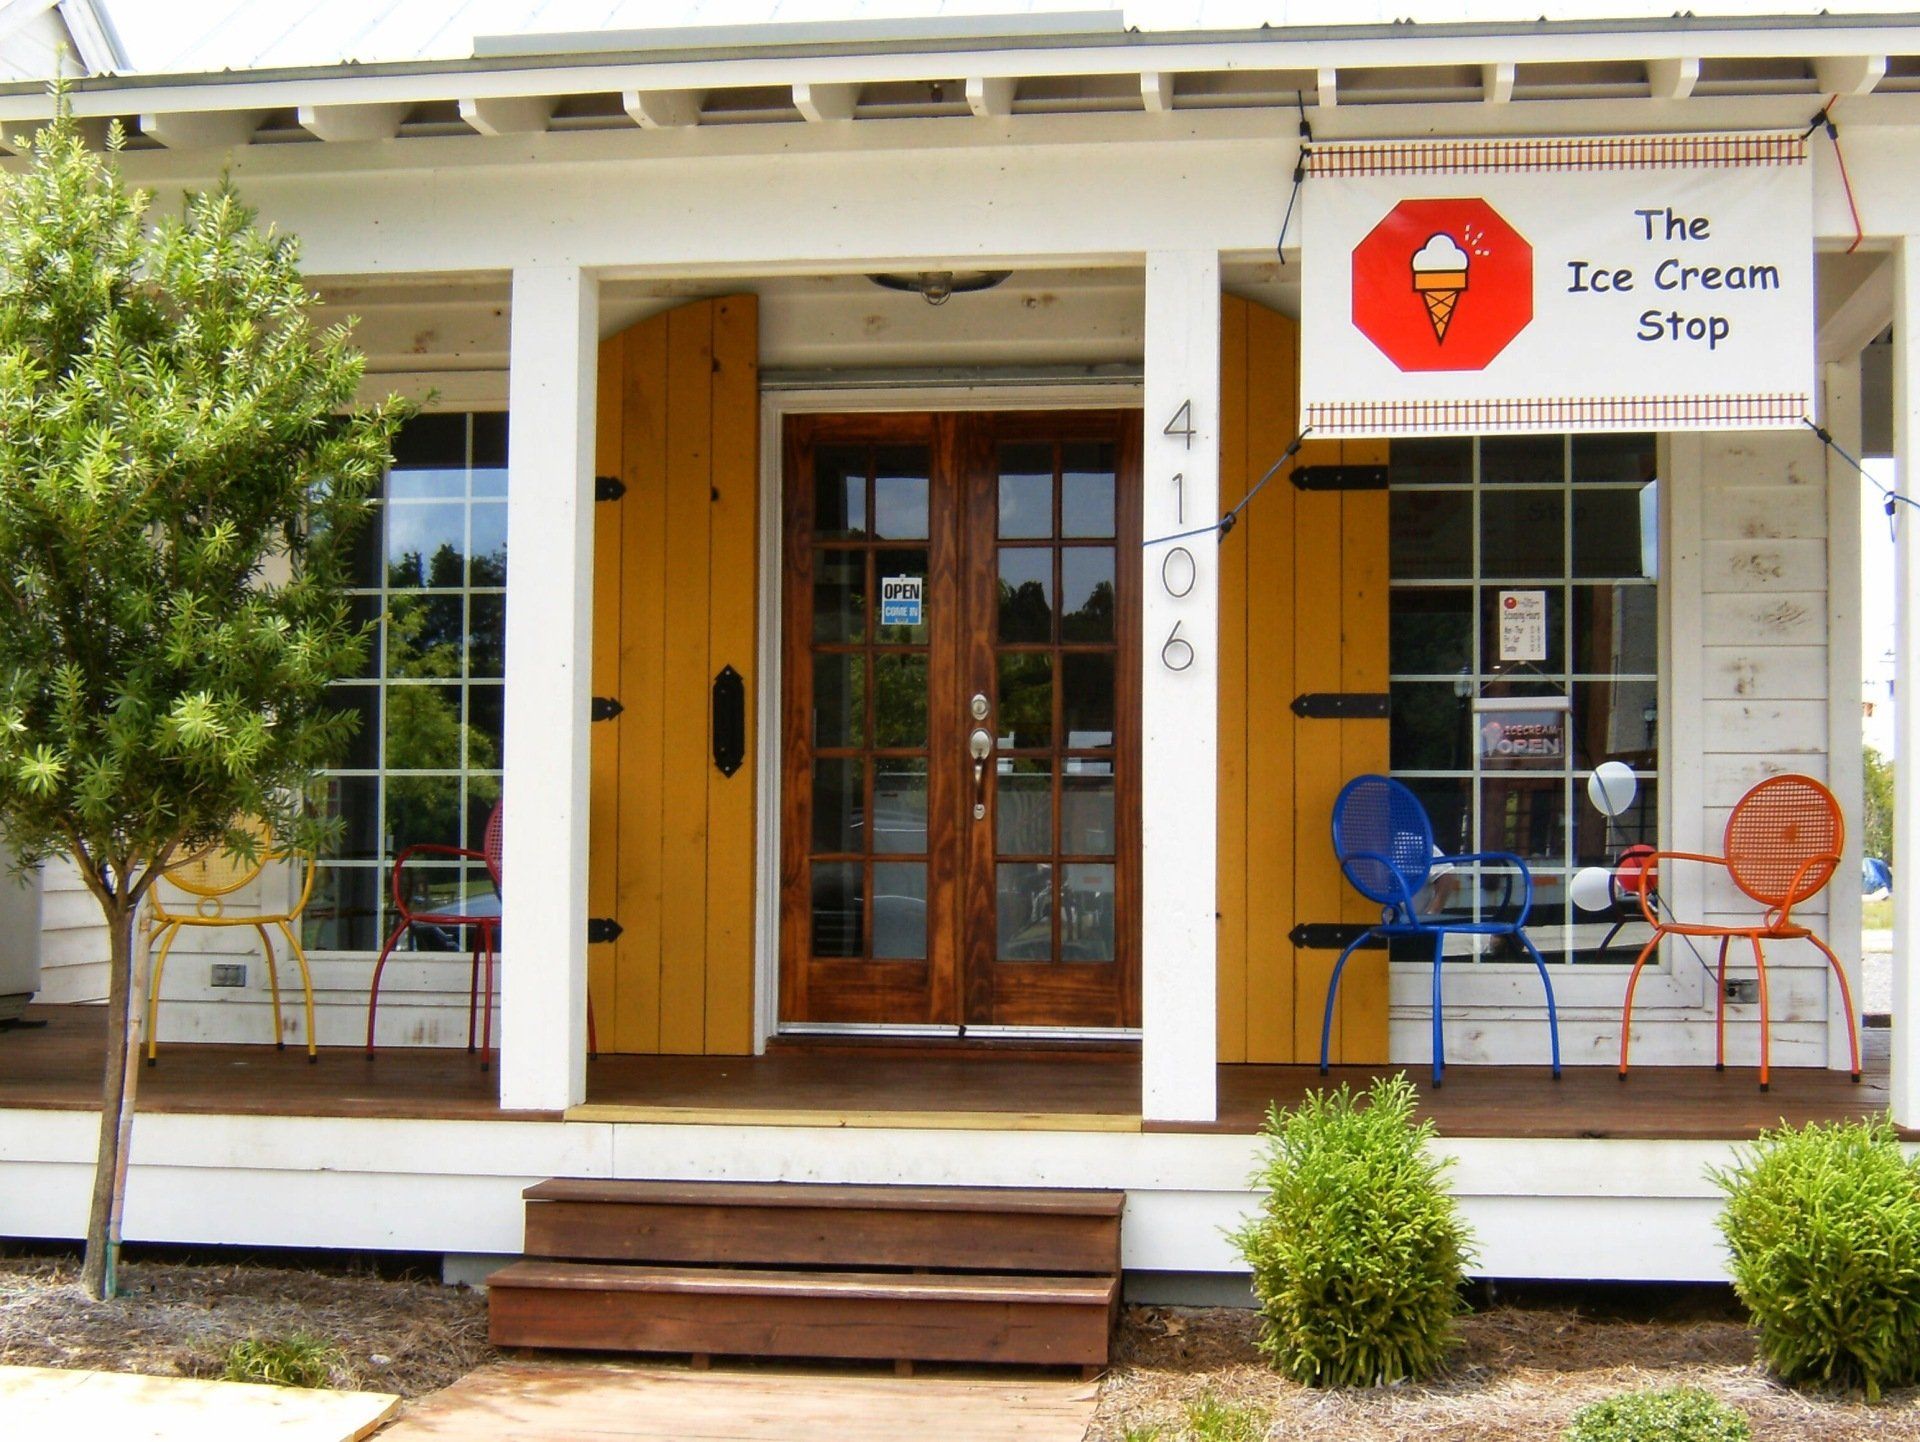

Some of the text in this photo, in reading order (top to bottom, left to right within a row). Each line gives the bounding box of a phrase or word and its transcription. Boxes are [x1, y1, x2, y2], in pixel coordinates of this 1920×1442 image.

[1635, 207, 1710, 241] The
[1567, 259, 1780, 293] Ice Cream
[1637, 310, 1730, 350] Stop
[1162, 399, 1197, 671] 4106
[884, 583, 920, 599] OPEN
[885, 607, 908, 616] COME
[1497, 739, 1560, 754] OPEN
